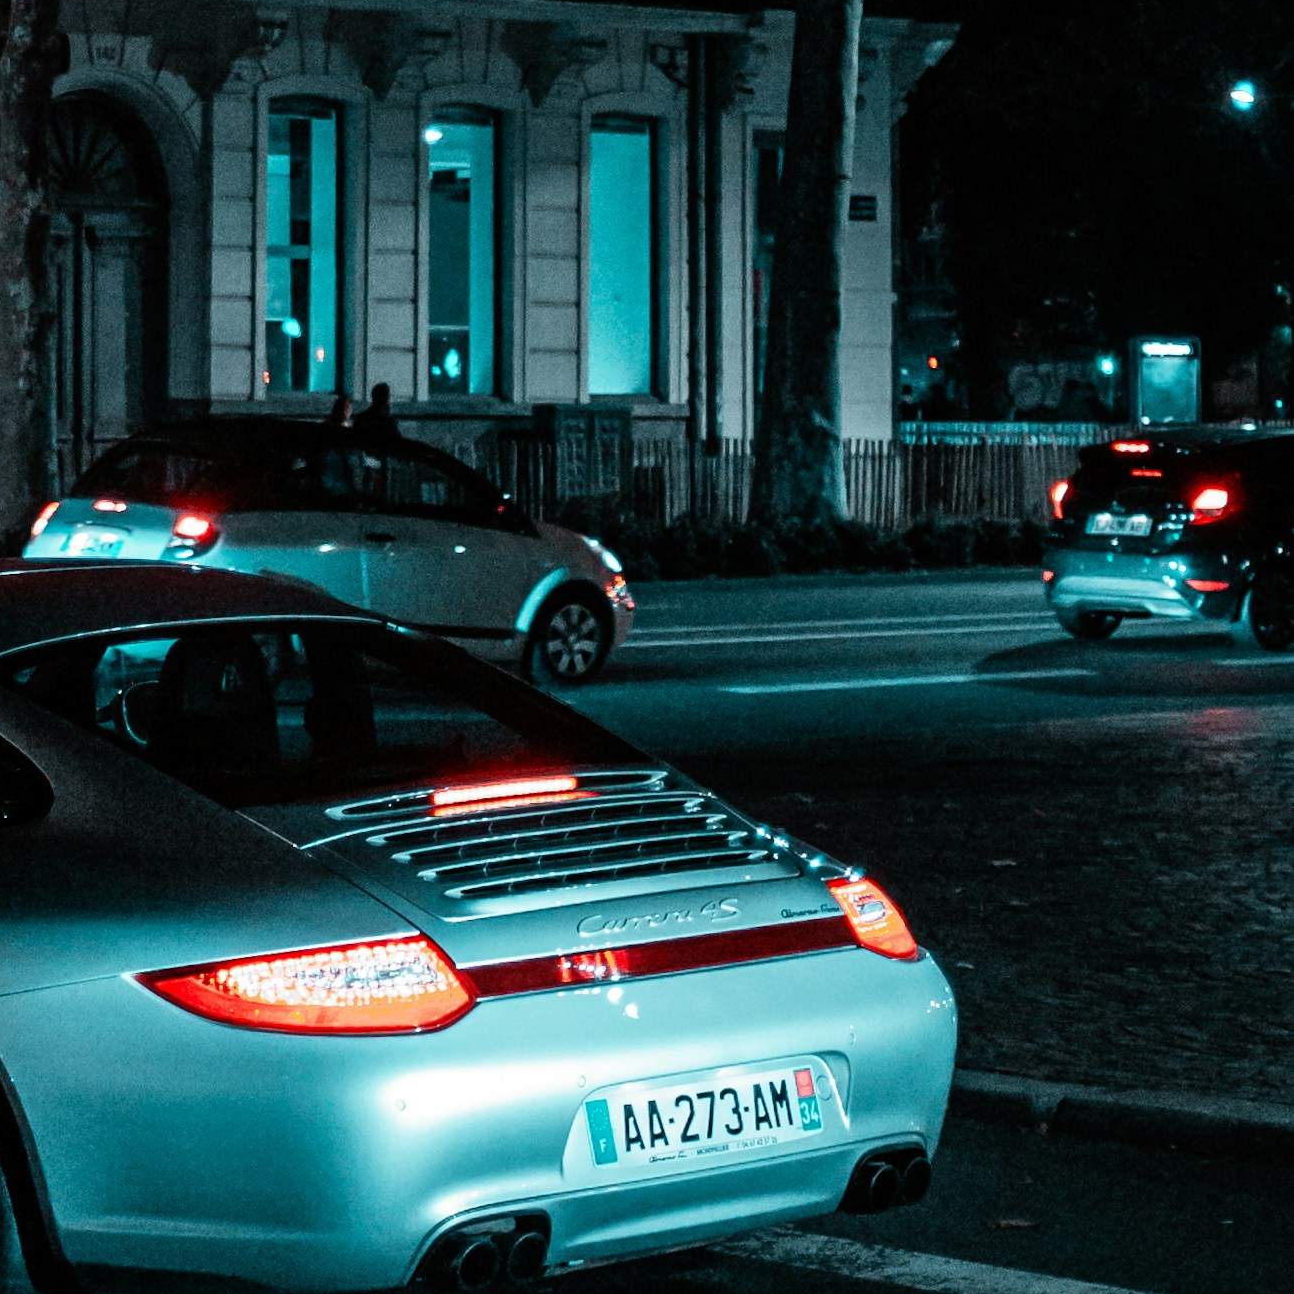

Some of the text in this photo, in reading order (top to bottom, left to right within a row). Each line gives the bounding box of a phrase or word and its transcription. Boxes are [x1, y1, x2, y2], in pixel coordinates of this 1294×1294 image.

[575, 897, 739, 938] Carrera 4S
[623, 1079, 794, 1152] AA-273-AM
[800, 1100, 819, 1124] 34
[599, 1138, 607, 1153] F
